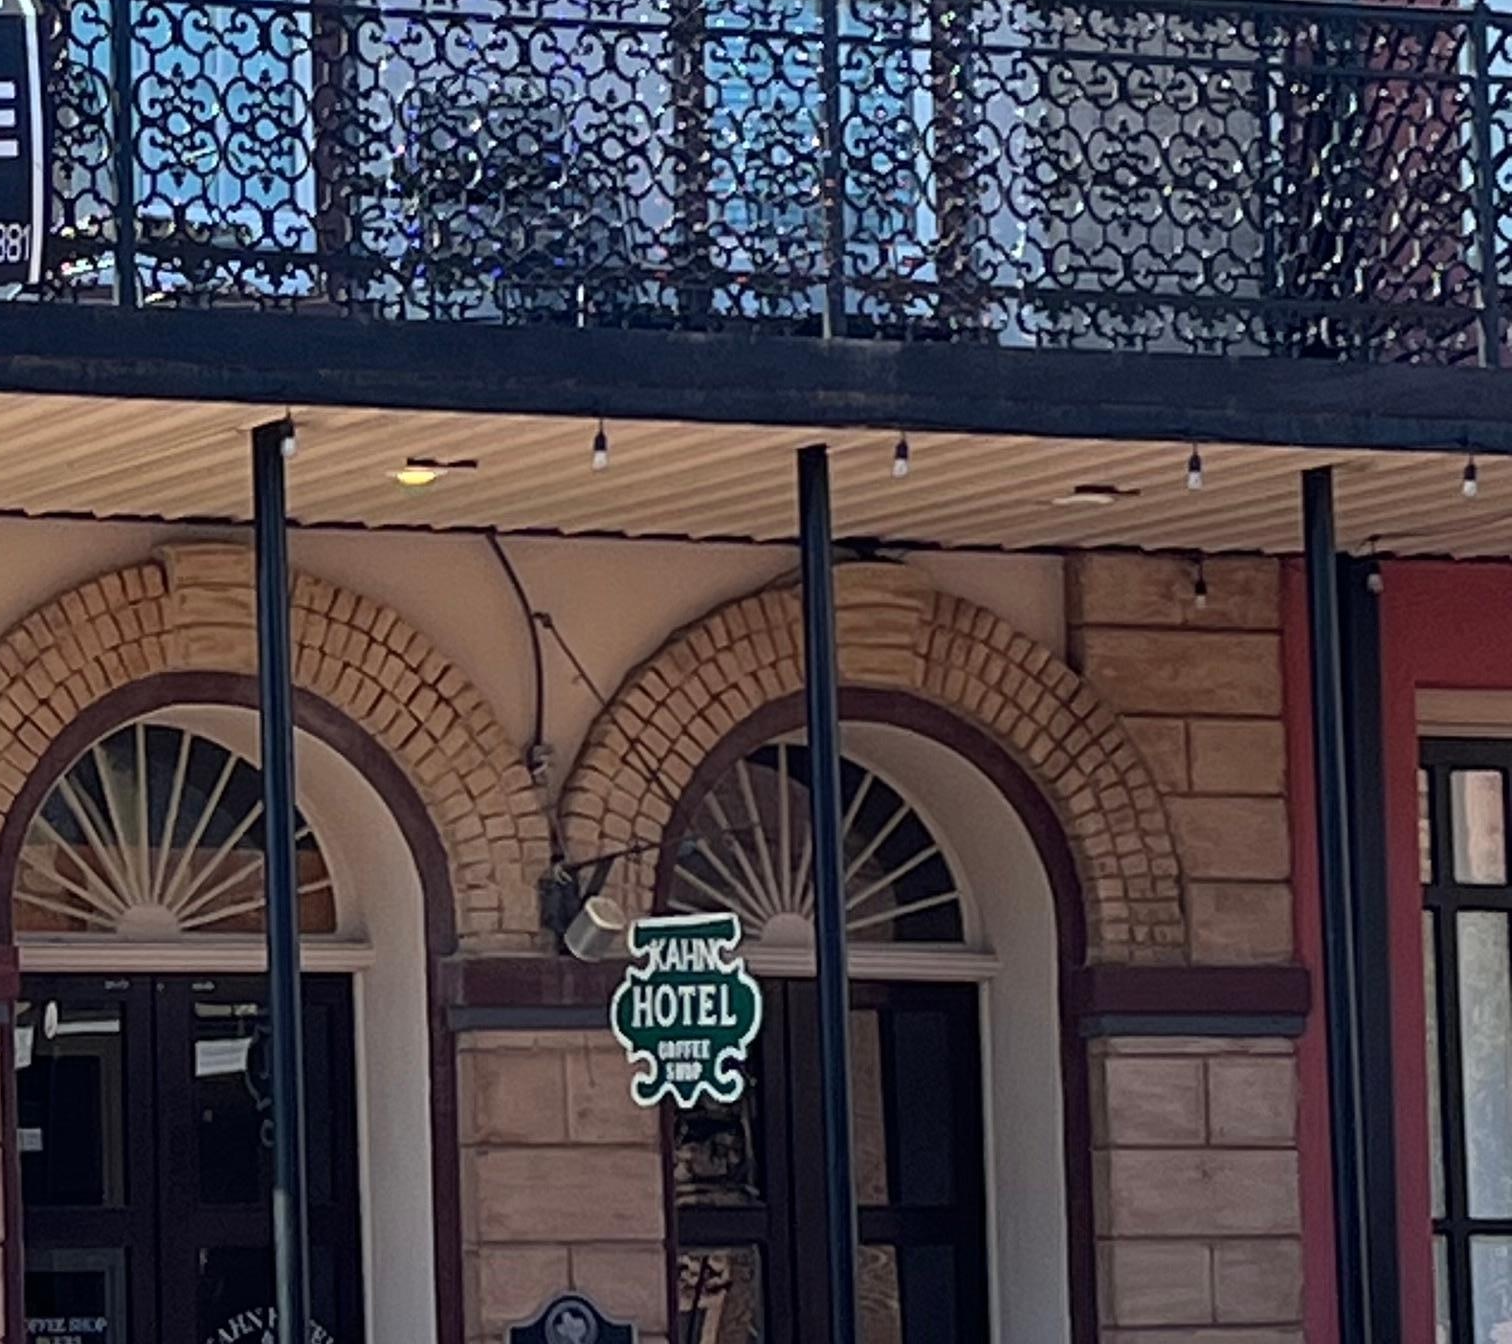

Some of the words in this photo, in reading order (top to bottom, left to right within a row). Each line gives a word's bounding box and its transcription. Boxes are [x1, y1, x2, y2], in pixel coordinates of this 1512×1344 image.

[649, 937, 723, 972] KAHN
[631, 983, 737, 1028] HOTEL
[657, 1039, 711, 1060] COFFEE
[666, 1062, 703, 1081] SHOP
